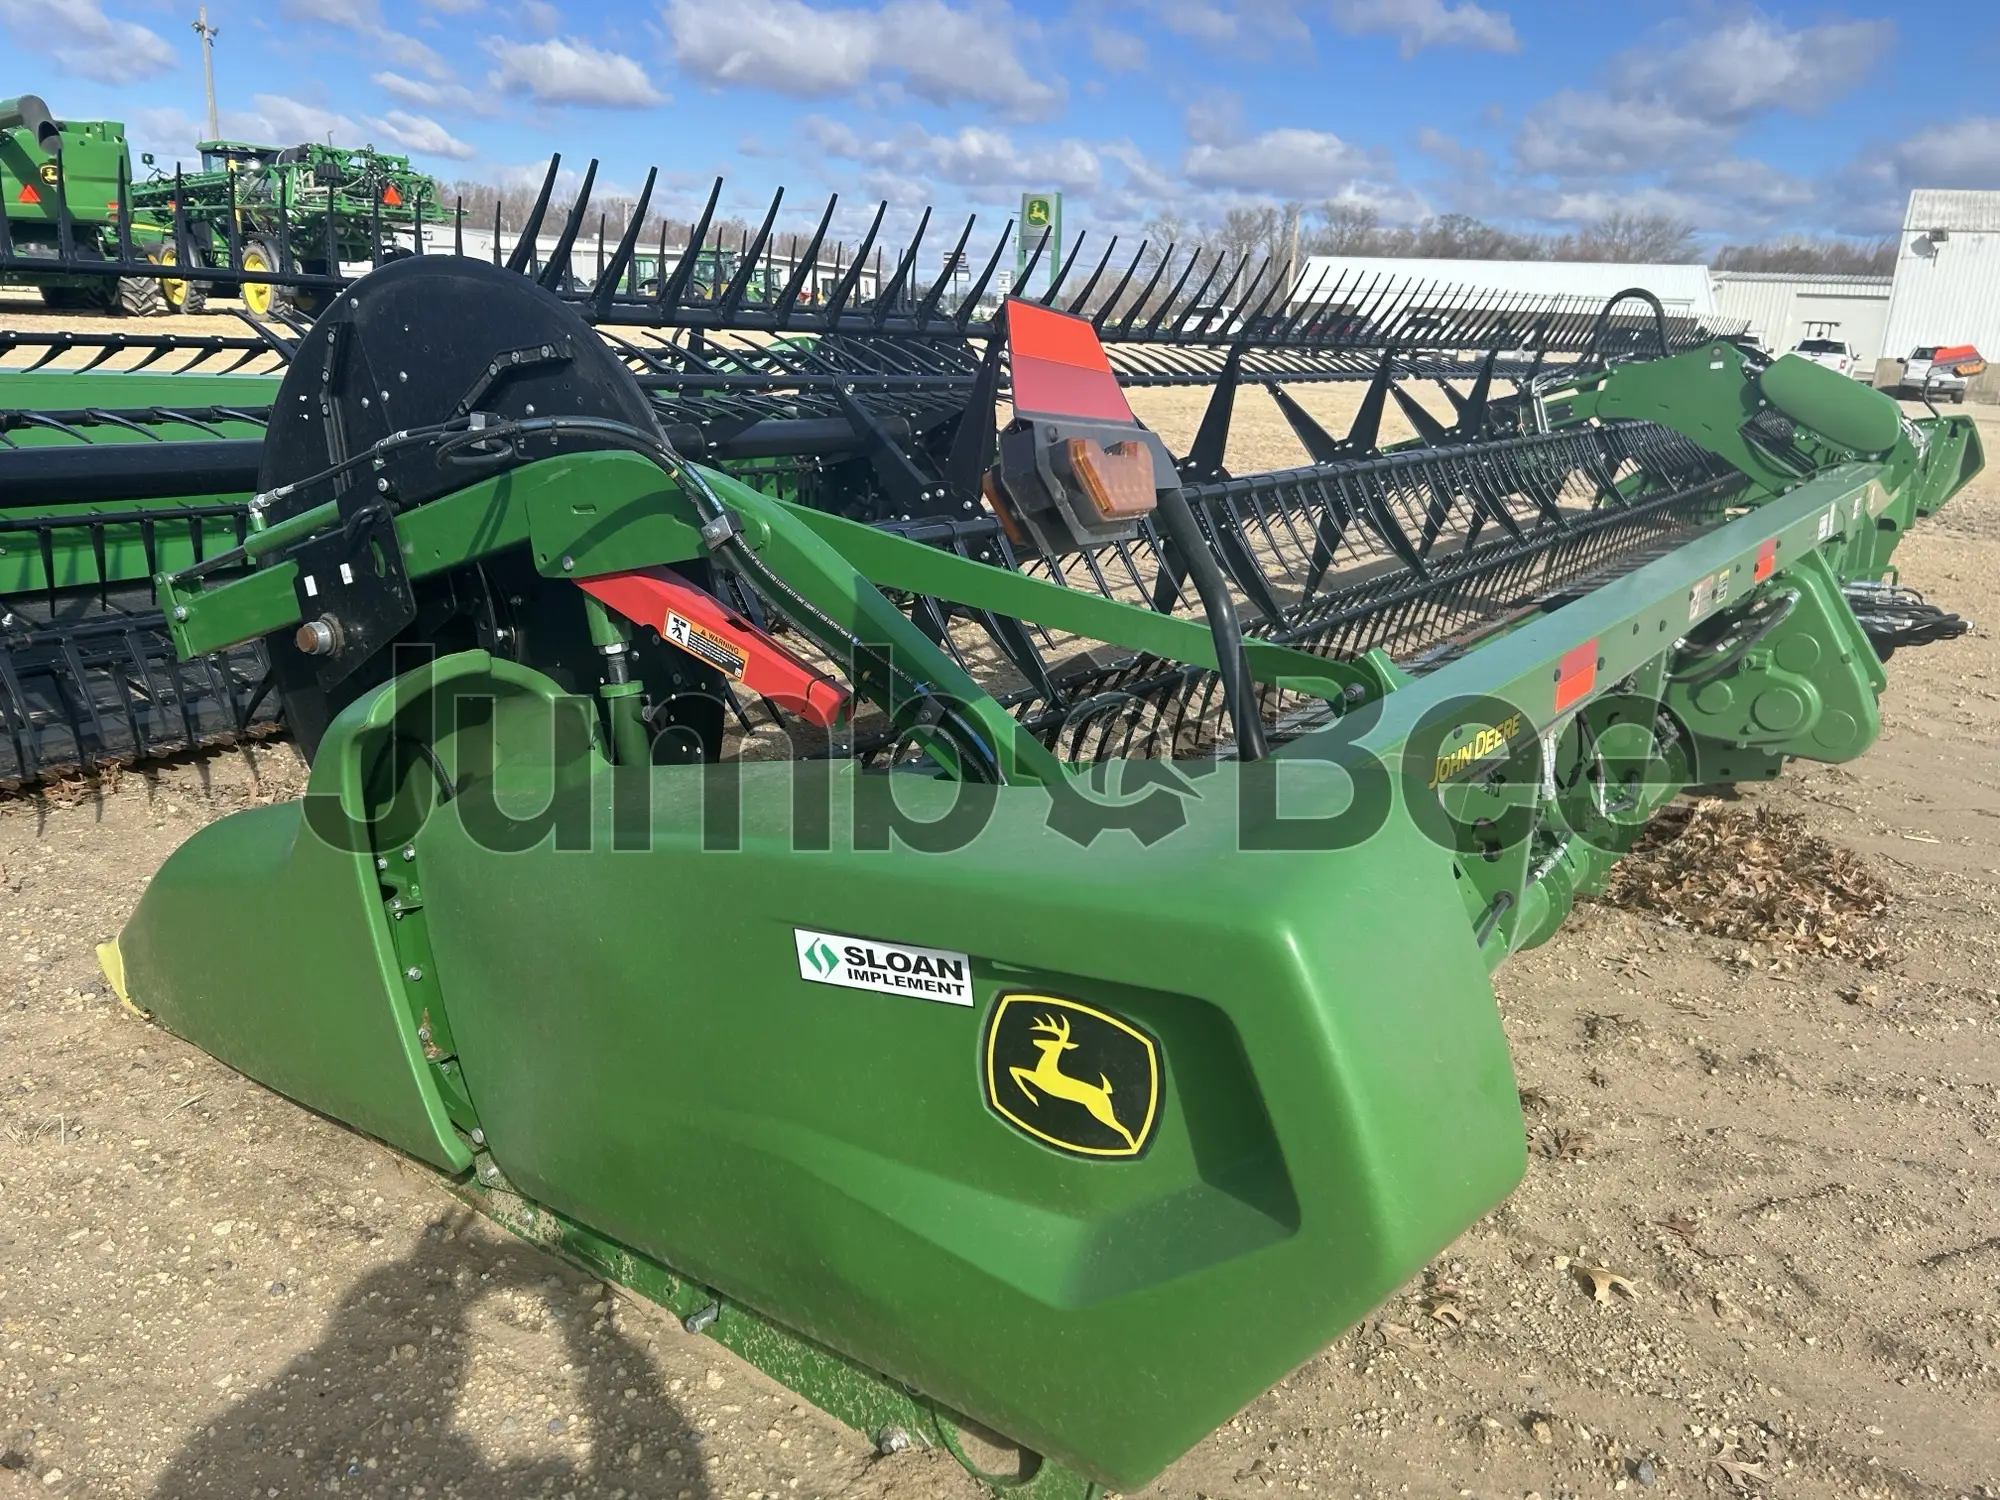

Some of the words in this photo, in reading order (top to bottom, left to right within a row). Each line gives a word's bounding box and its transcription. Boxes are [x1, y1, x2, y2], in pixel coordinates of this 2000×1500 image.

[708, 633, 739, 655] WARNING
[1427, 741, 1474, 790] JOHN
[1473, 711, 1522, 761] DEERE
[844, 945, 964, 981] SLOAN
[847, 967, 965, 997] IMPLEMENT
